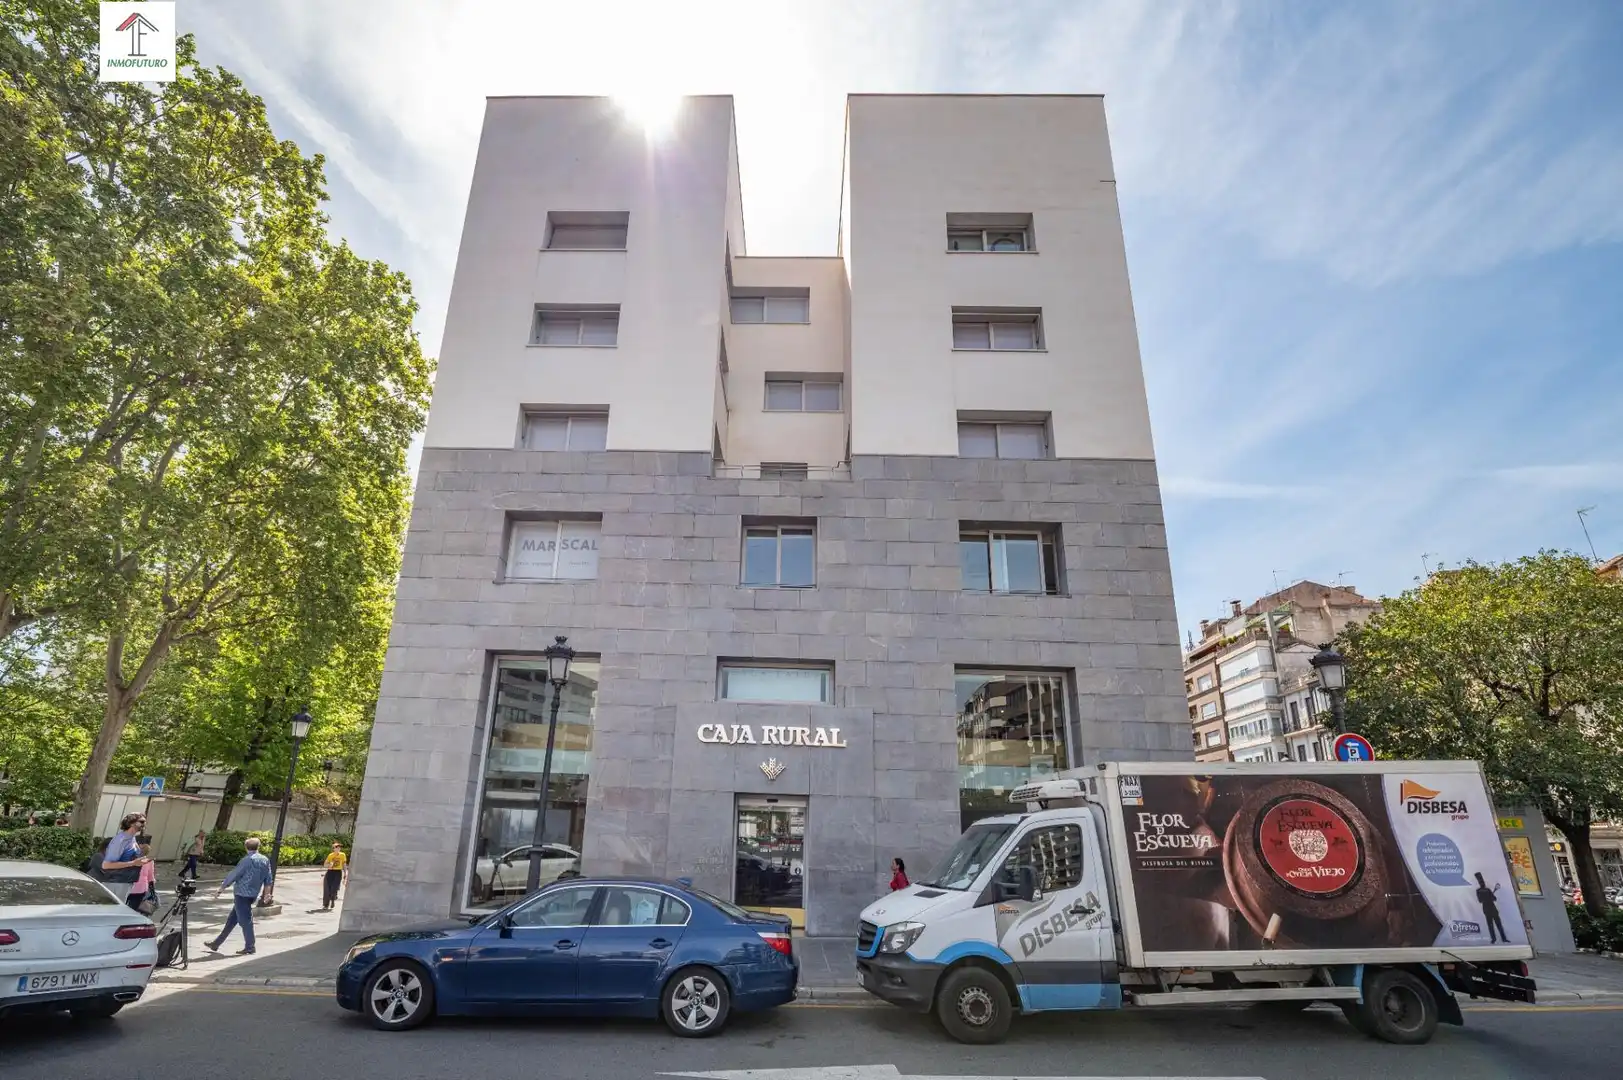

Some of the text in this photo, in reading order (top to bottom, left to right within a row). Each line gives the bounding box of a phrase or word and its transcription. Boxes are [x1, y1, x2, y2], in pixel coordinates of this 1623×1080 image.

[522, 540, 599, 551] MARSCAL
[697, 724, 847, 748] CAJA RURAL
[1407, 801, 1468, 814] DISBESA
[1137, 812, 1190, 832] FLOR
[1133, 831, 1219, 852] ESGUEVA
[1019, 891, 1101, 957] DISBESA
[31, 972, 97, 988] 6791 MNX
